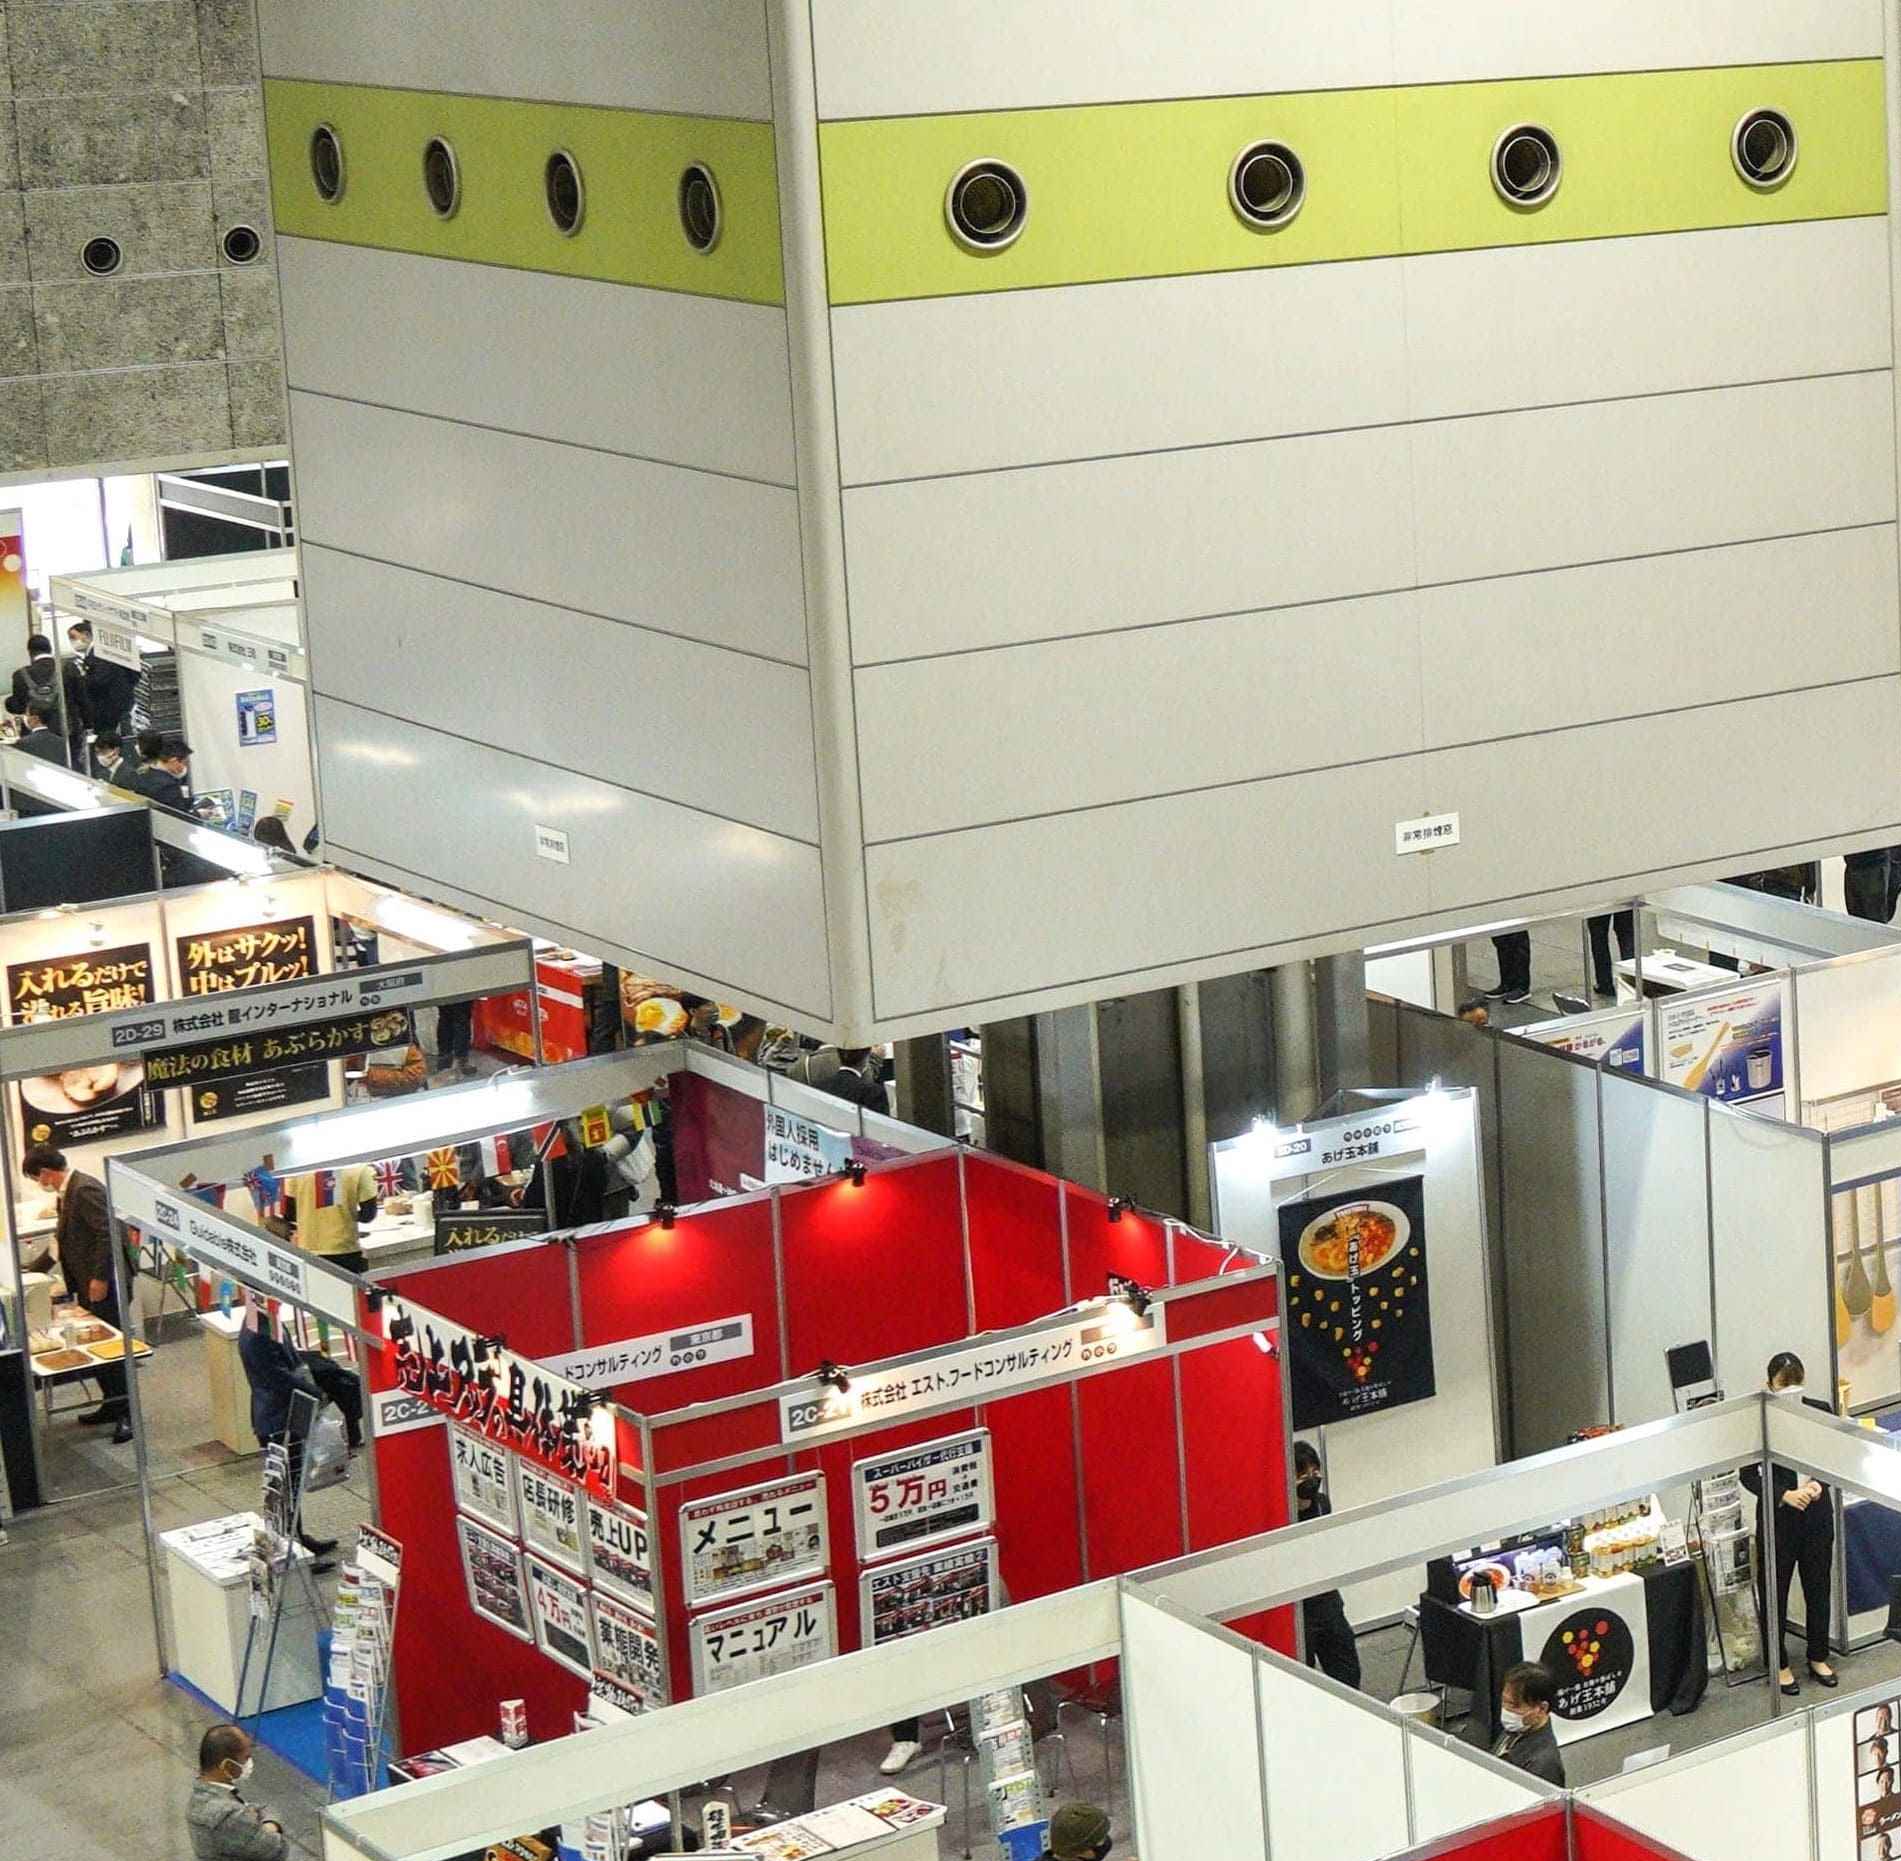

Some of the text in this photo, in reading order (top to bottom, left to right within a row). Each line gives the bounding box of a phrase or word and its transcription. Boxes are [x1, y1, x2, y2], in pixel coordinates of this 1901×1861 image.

[187, 926, 308, 967] 外はサクッ!
[16, 958, 148, 1000] 入れるだけで
[115, 1023, 165, 1044] 2D-29
[173, 1011, 225, 1034] 株式会社
[147, 1025, 370, 1081] 魔法の食材 あぶらかす
[1322, 1141, 1379, 1165] あげ玉本舗
[861, 1381, 908, 1409] 株式会社
[870, 1474, 948, 1514] 5万円
[589, 1508, 650, 1561] 売上UP
[693, 1503, 813, 1555] メニュー
[706, 1608, 817, 1664] マニュアル
